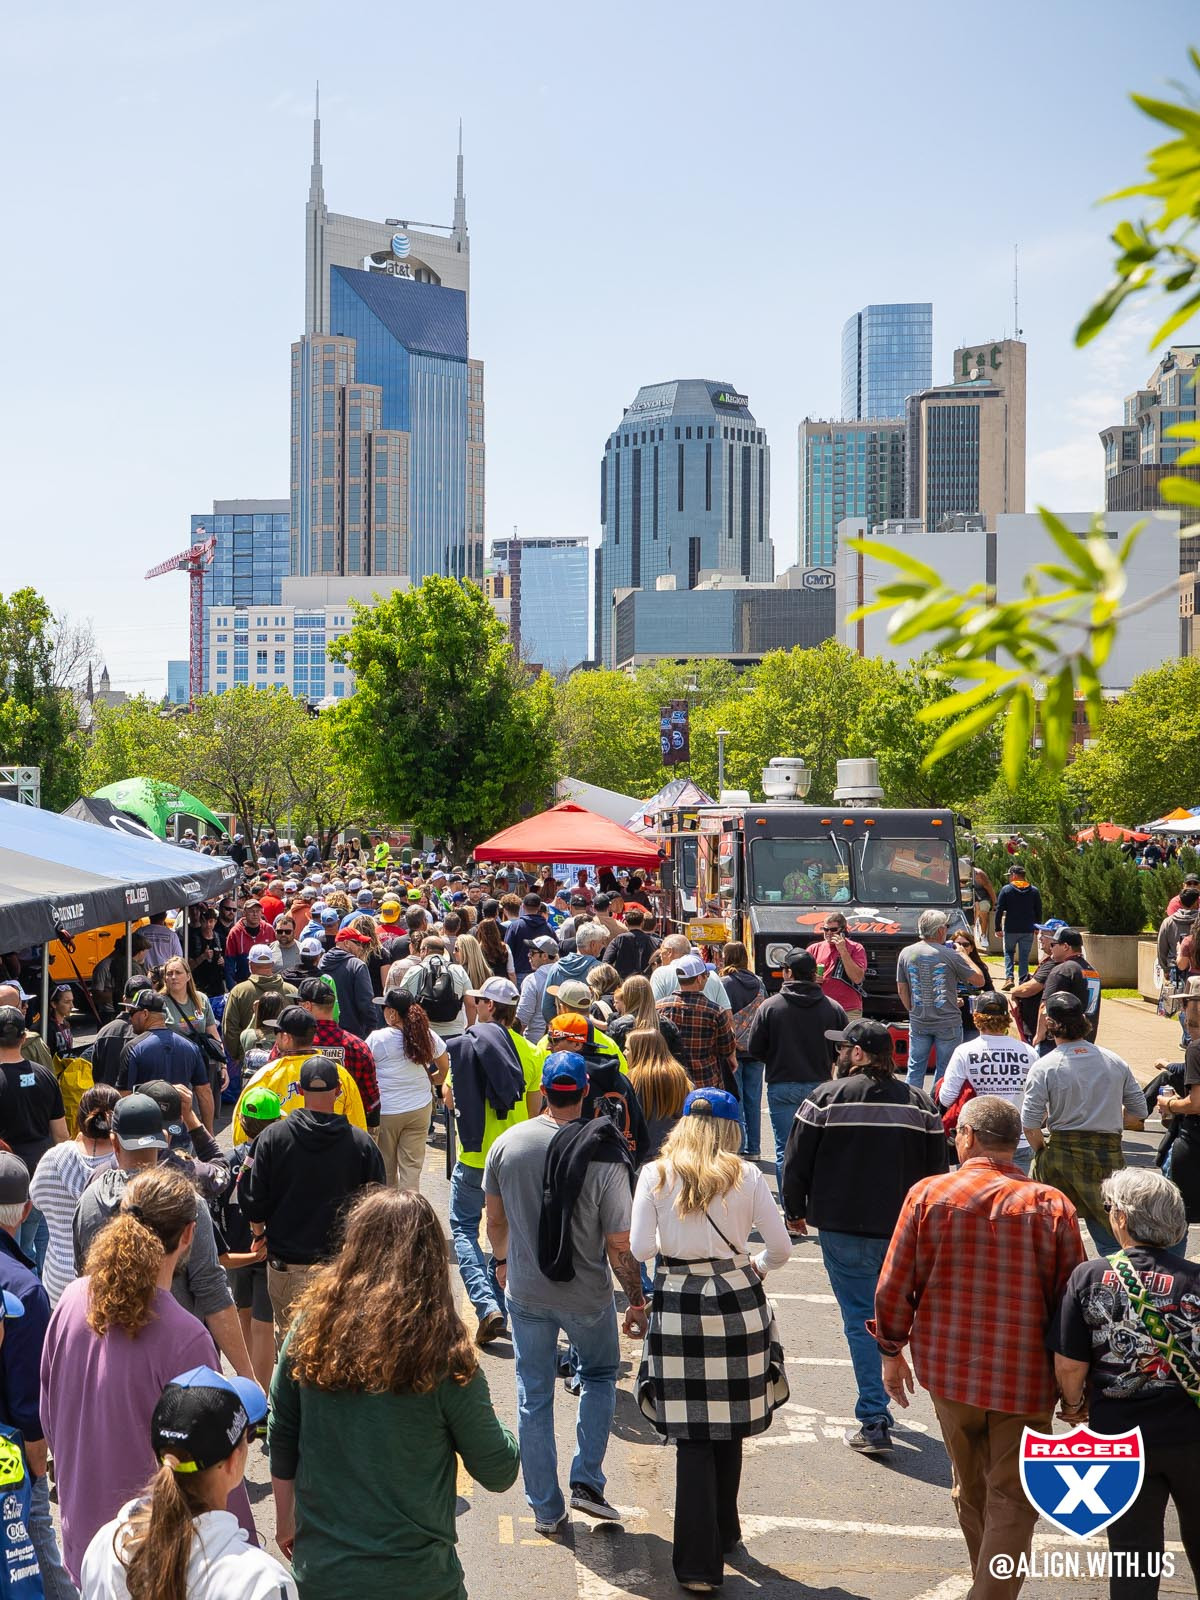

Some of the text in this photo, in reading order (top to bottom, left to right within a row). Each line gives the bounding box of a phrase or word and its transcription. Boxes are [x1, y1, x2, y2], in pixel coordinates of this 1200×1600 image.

[386, 262, 411, 278] at&t
[806, 574, 832, 585] CMT
[969, 1051, 1030, 1065] RACING
[980, 1064, 1020, 1076] CLUB
